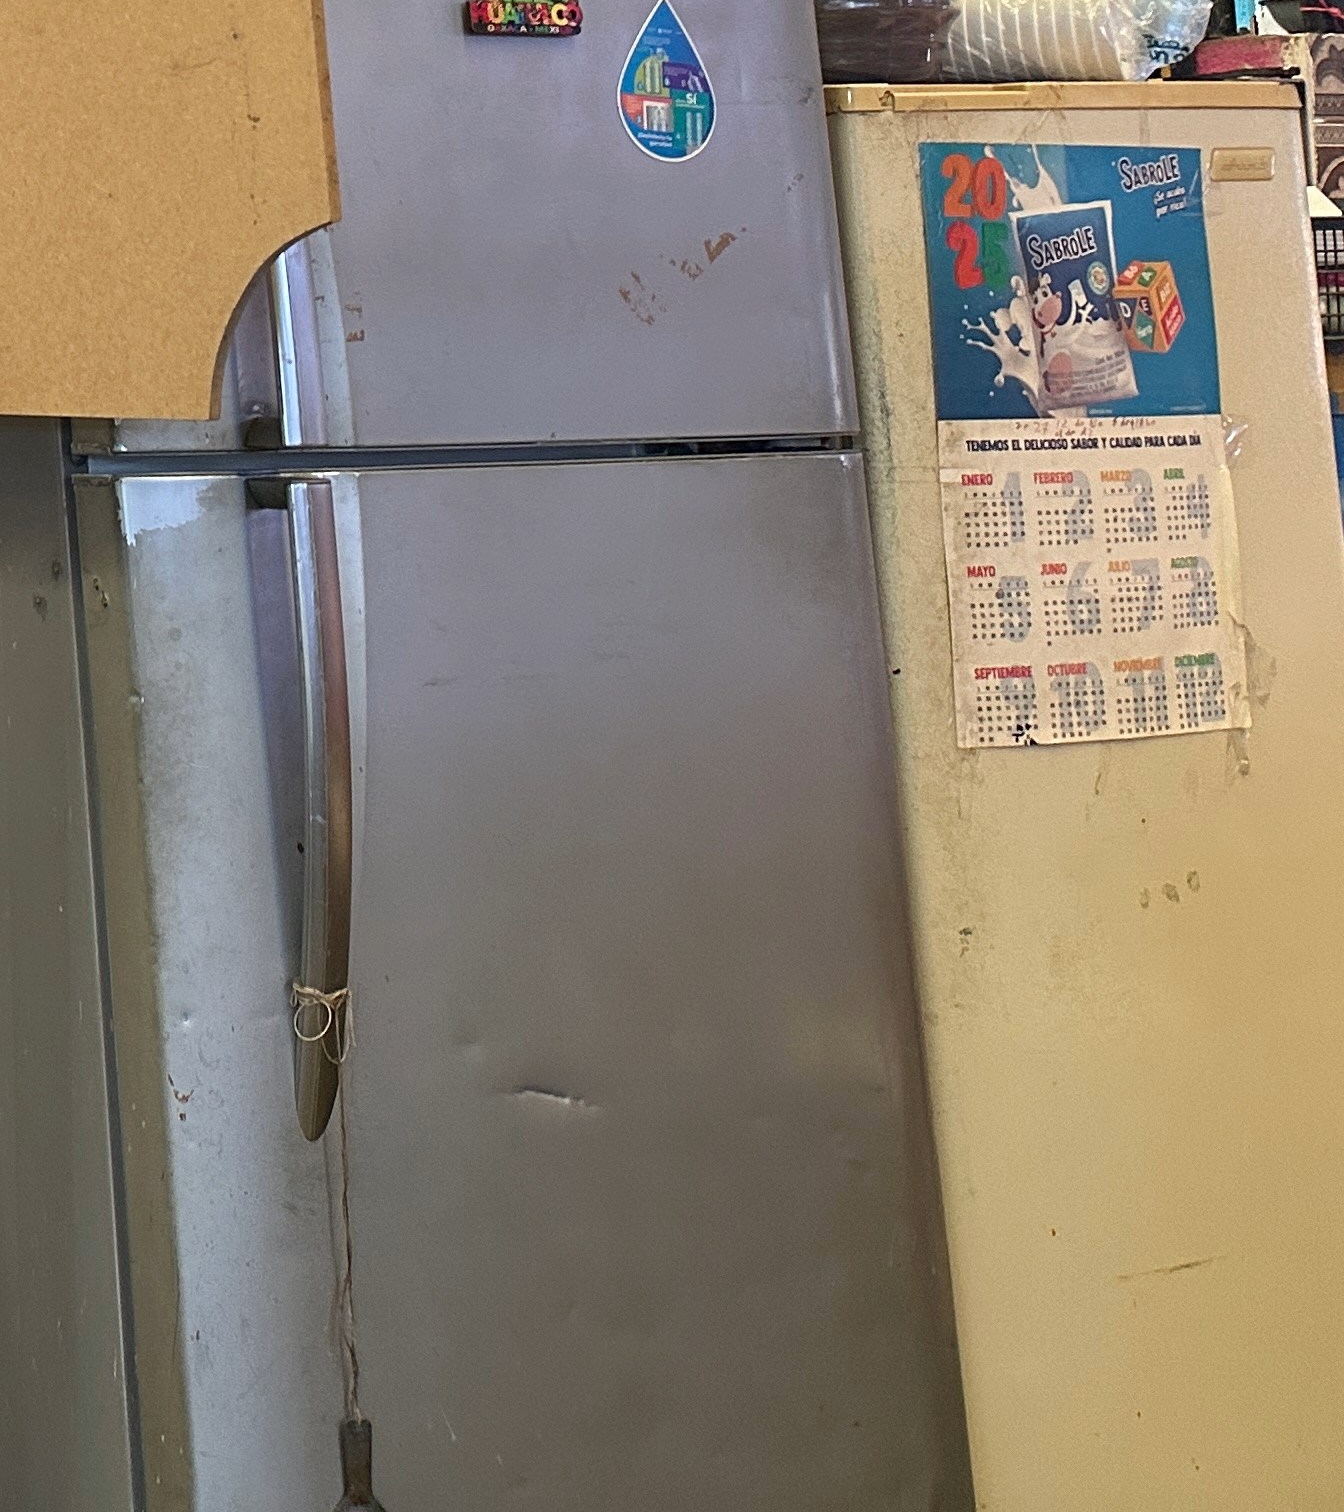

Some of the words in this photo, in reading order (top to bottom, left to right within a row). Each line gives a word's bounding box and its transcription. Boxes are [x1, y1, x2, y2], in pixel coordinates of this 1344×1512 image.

[1118, 154, 1181, 192] SABROLE
[941, 153, 1007, 219] 20
[945, 220, 1009, 291] 25
[1026, 225, 1098, 270] SABROLE
[965, 439, 1009, 453] TENEMOS
[1011, 439, 1022, 452] EL
[1070, 438, 1099, 450] SABOR
[1101, 437, 1108, 449] Y
[1110, 436, 1142, 448] CALIDAD
[1145, 435, 1164, 448] PARA
[1167, 434, 1187, 447] CADA
[961, 473, 993, 486] ENERO
[1033, 472, 1074, 484] FEBRERO
[967, 565, 996, 578] MAYO
[1040, 563, 1067, 576] JUNIO
[974, 664, 1033, 680] SEPTIEMBRE
[1047, 662, 1088, 677] OCTUBRE
